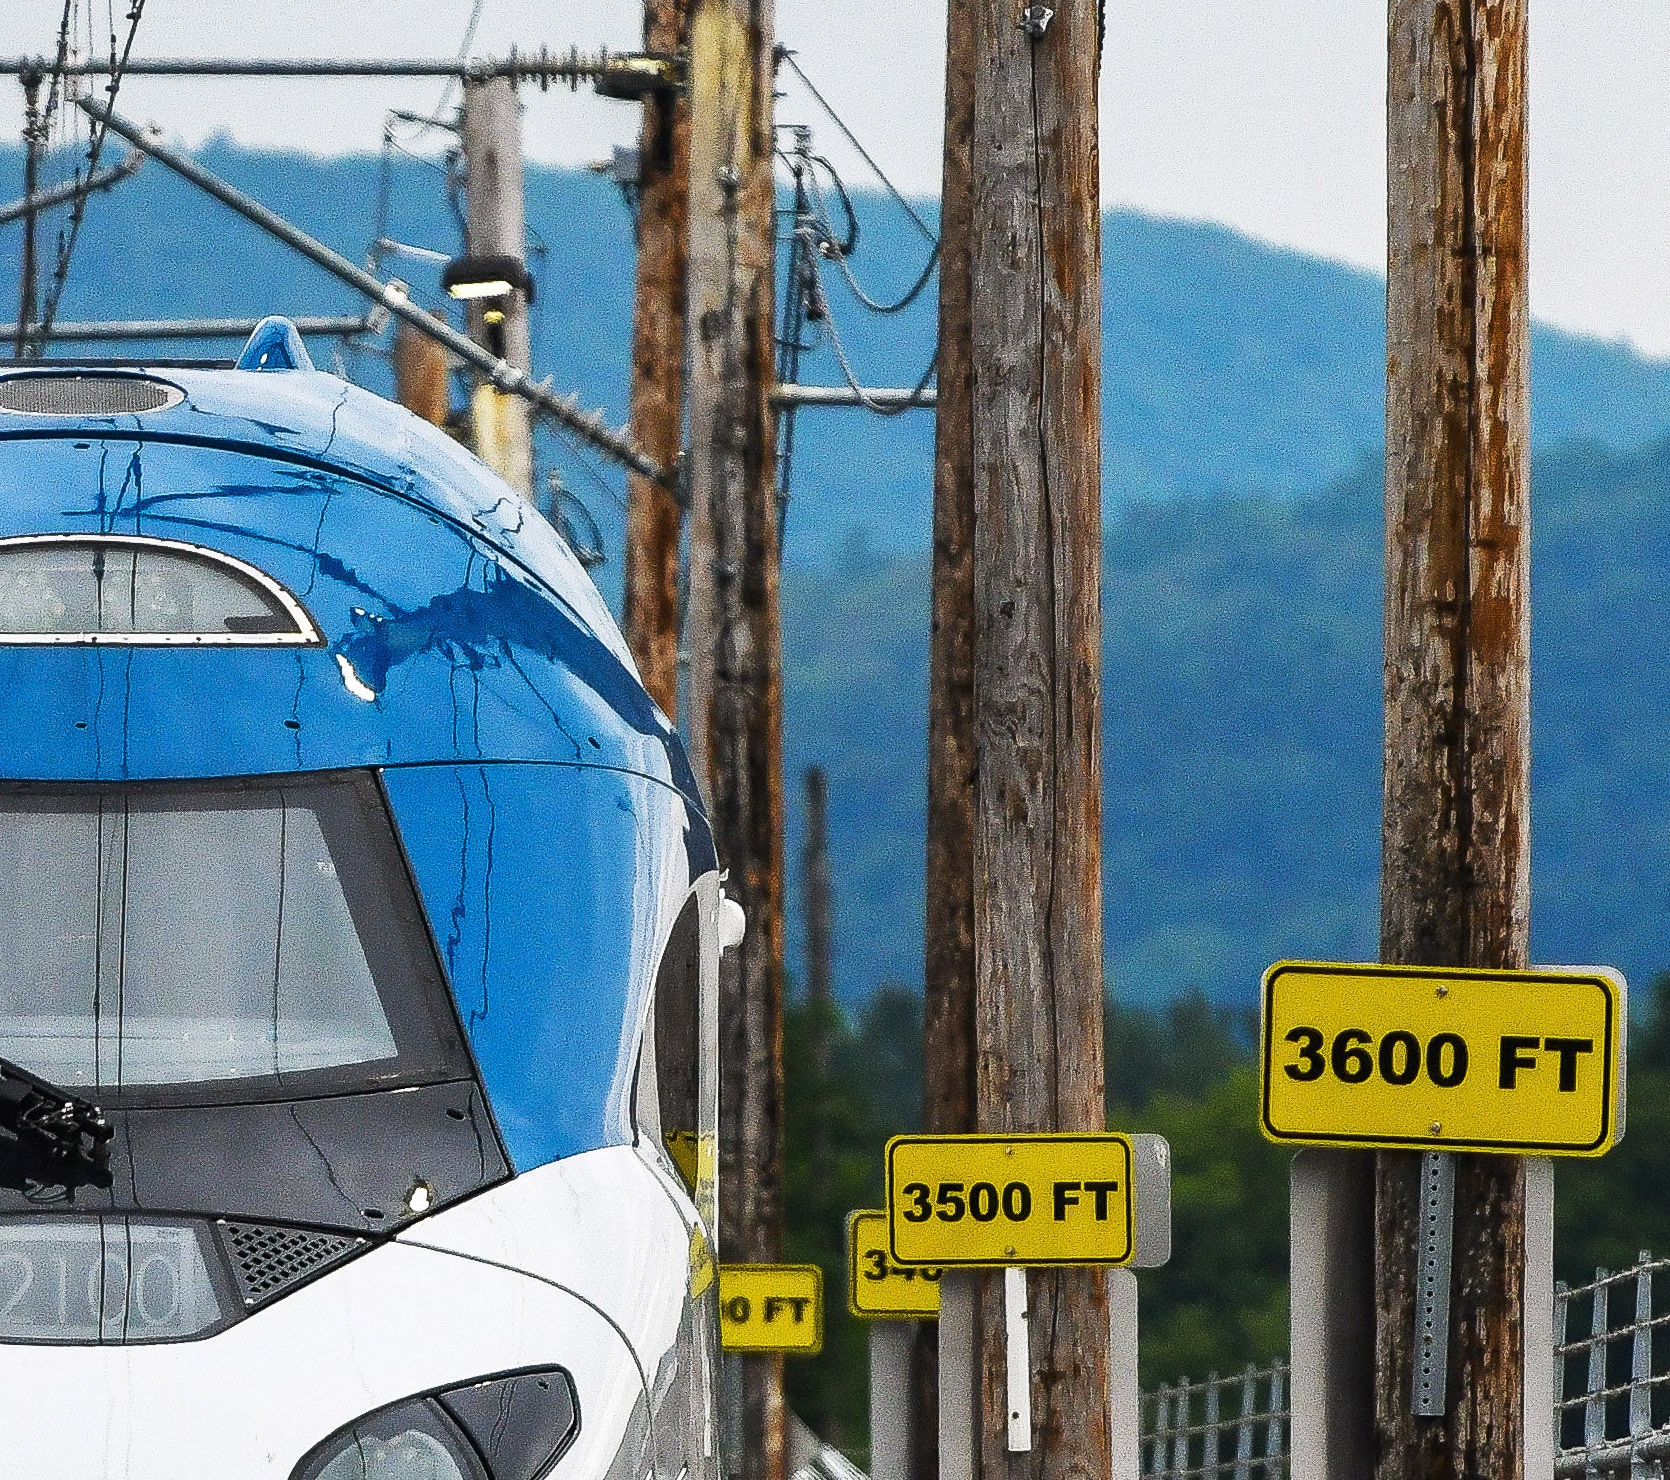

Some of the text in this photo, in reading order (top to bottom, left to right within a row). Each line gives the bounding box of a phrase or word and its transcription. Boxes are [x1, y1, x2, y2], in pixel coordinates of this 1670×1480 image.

[1283, 1026, 1595, 1094] 3600 FT
[902, 1181, 1120, 1223] 3500 FT
[763, 1296, 810, 1324] FT
